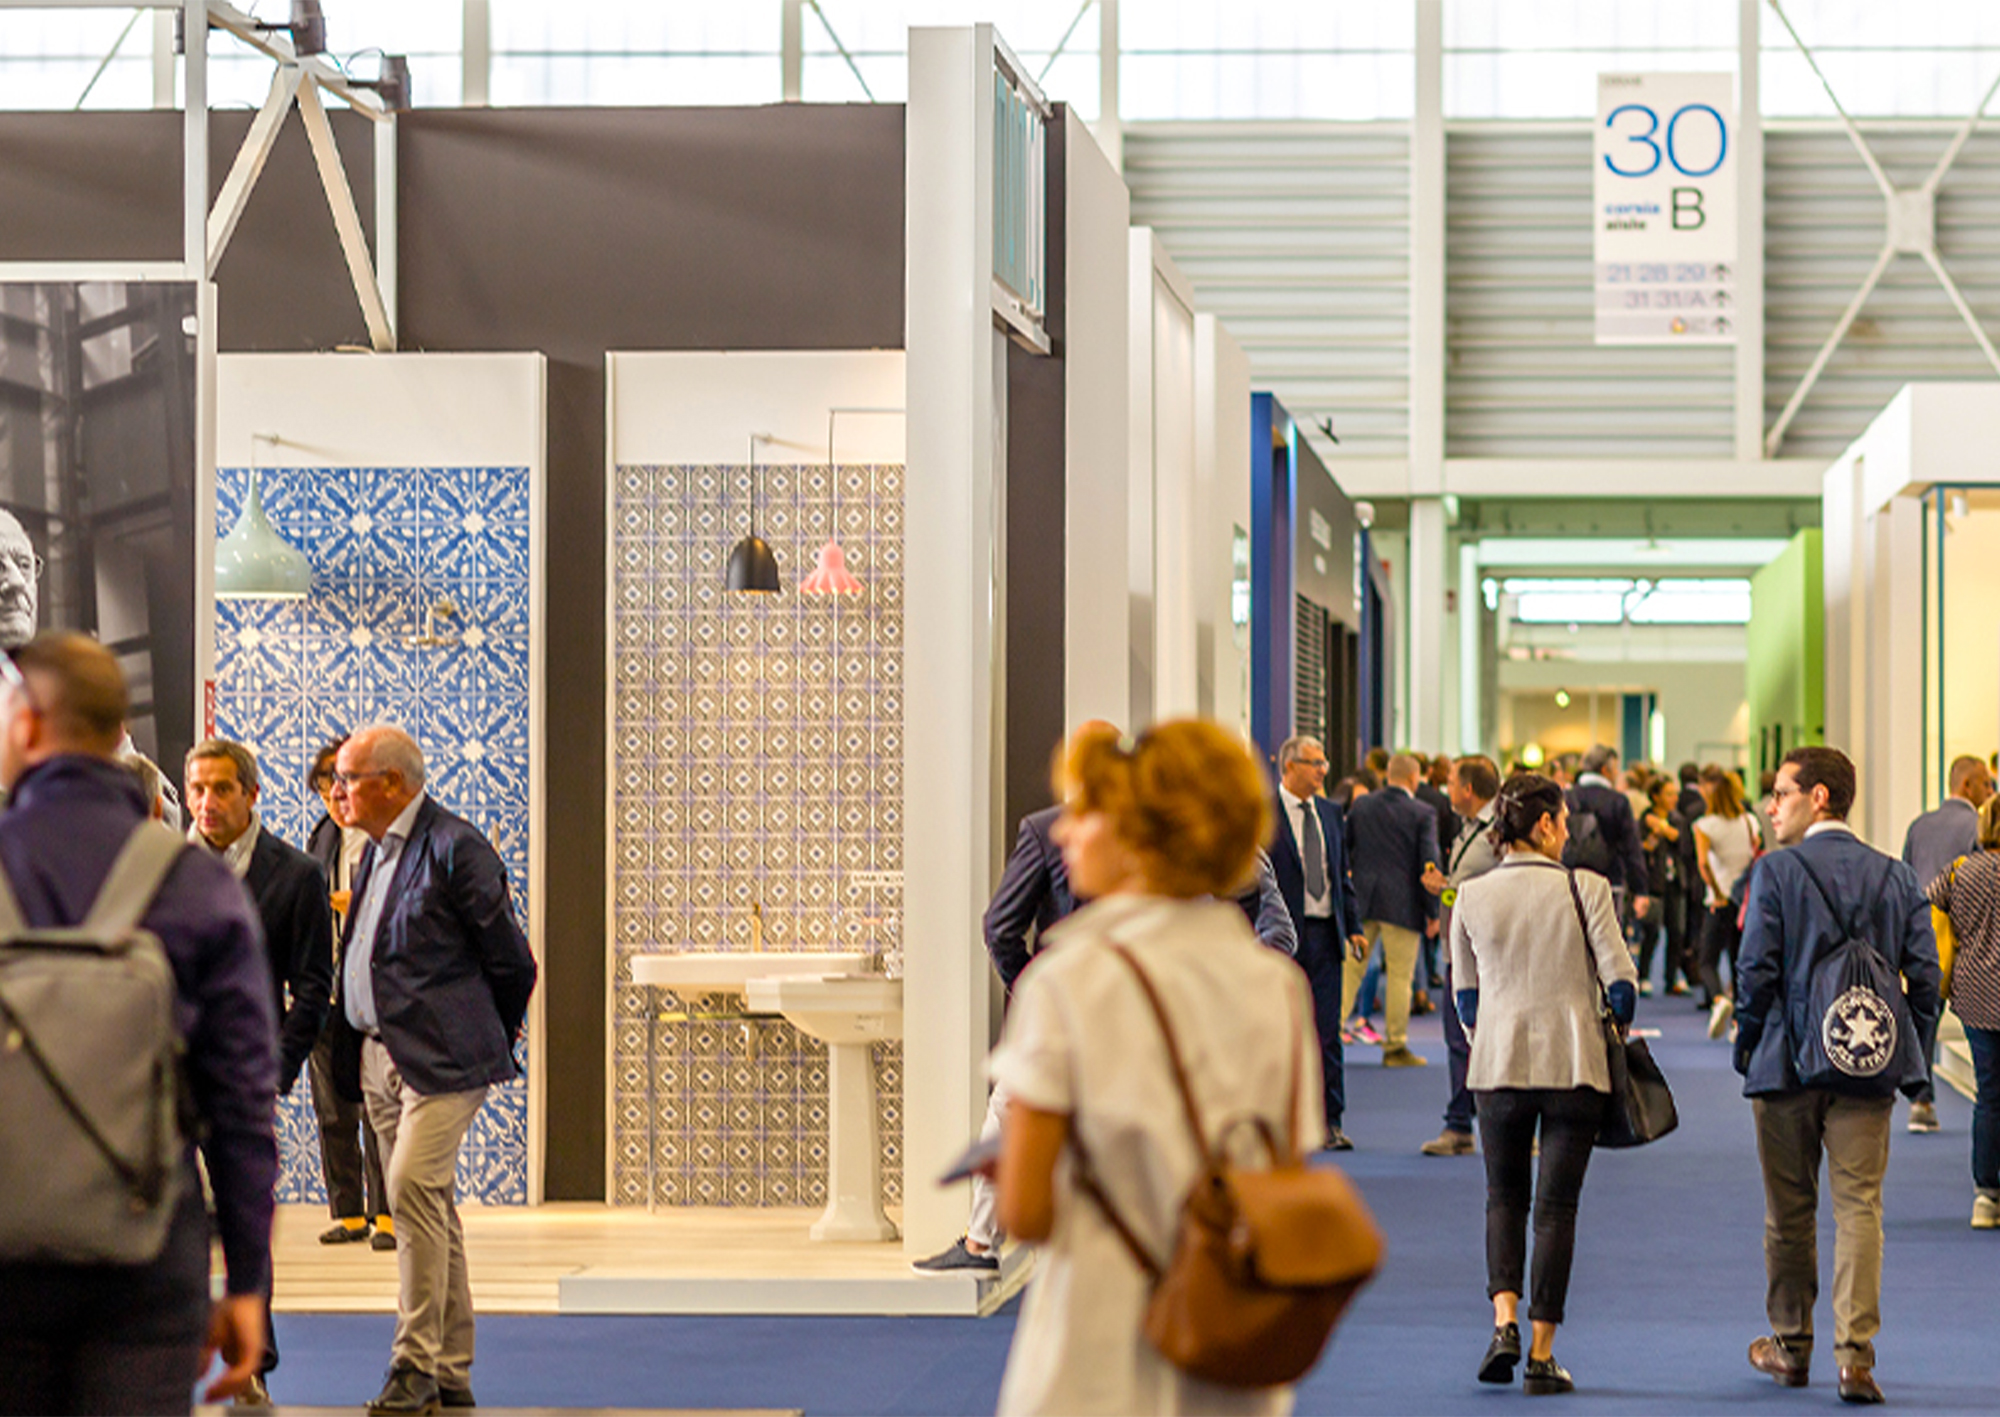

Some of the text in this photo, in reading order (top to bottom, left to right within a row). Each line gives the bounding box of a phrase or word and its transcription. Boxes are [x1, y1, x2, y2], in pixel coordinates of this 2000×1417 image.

[1604, 104, 1727, 177] 30
[1672, 186, 1706, 230] B
[1607, 263, 1631, 282] 21
[1625, 289, 1649, 308] 31
